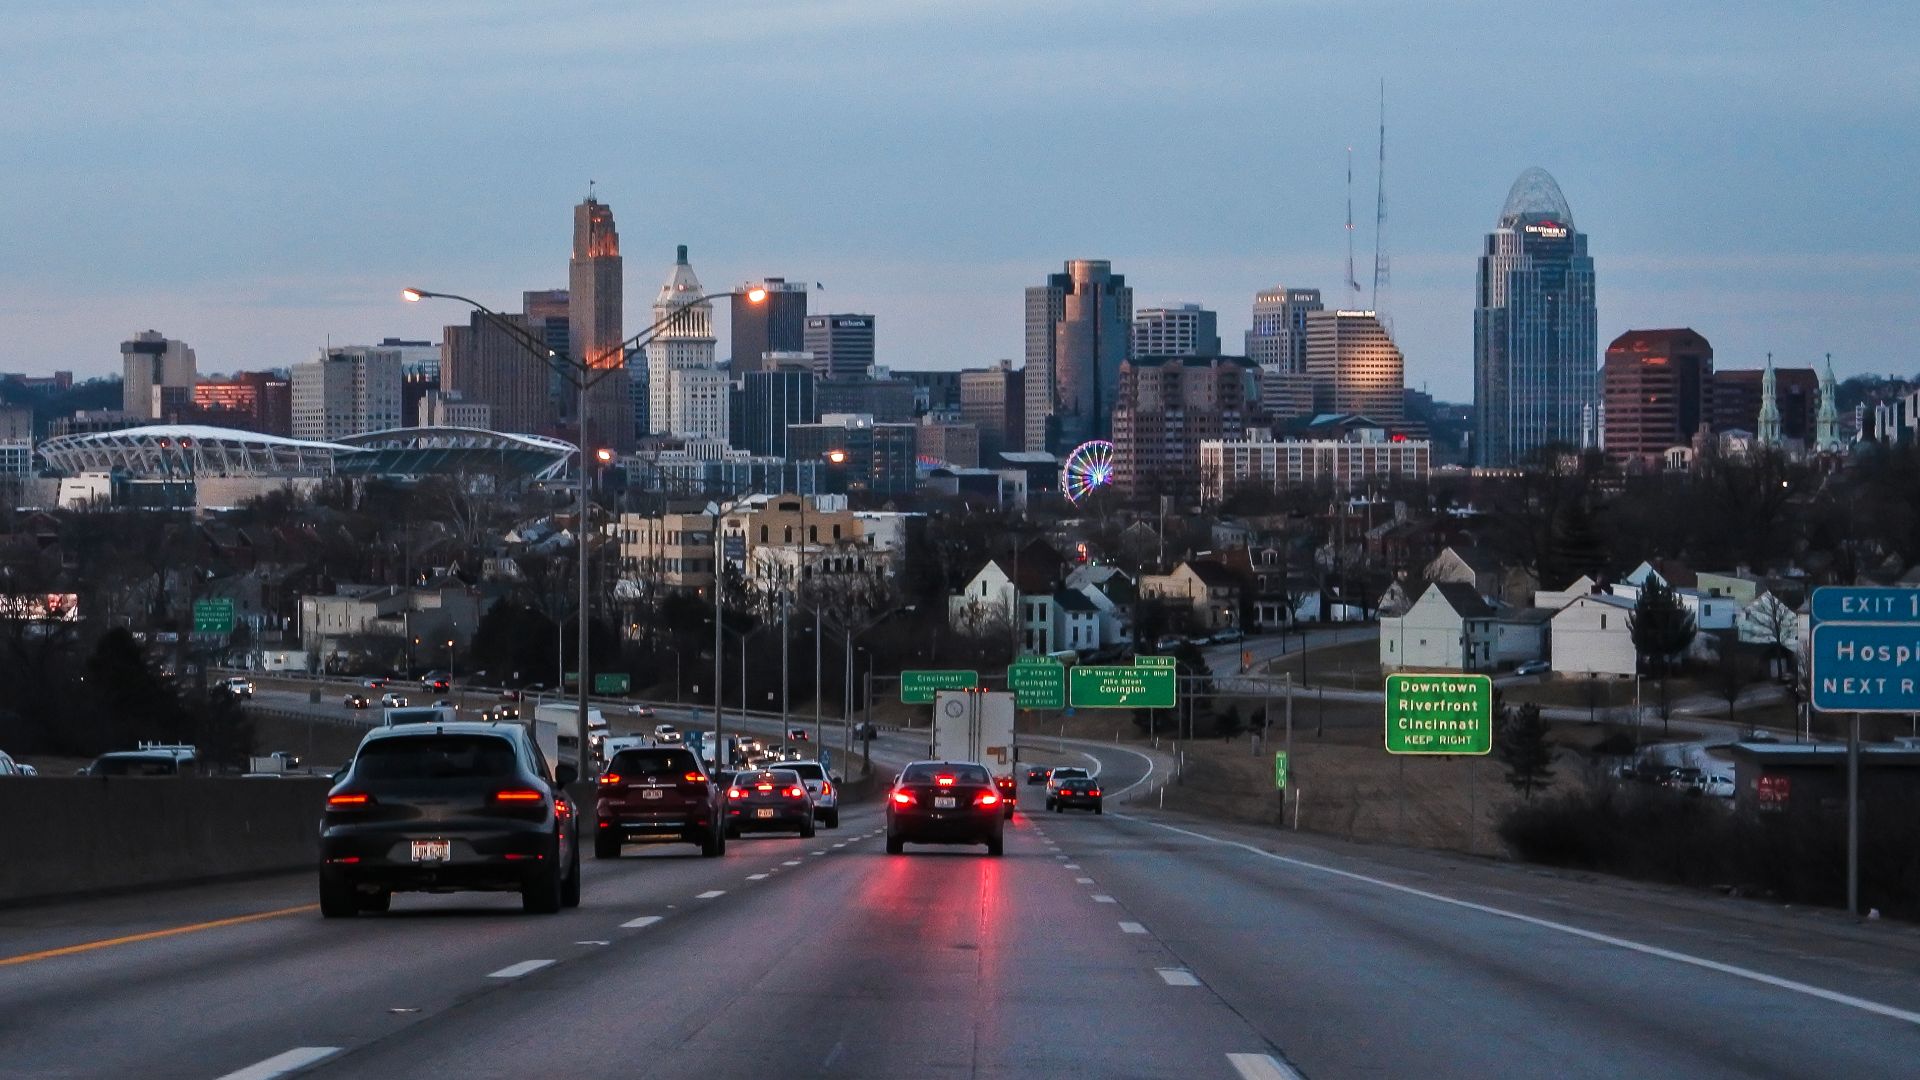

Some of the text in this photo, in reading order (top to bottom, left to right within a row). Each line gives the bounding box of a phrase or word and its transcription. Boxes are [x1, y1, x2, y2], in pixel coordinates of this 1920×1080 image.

[1842, 597, 1895, 613] EXIT
[917, 674, 962, 682] Cincinnati
[1014, 679, 1058, 688] Covington
[1100, 685, 1146, 694] Covington
[1400, 680, 1477, 693] Downtown
[1823, 677, 1887, 694] NEXT
[1018, 690, 1054, 698] Newport
[1399, 699, 1478, 711] Riverfront
[1398, 718, 1479, 730] Cincinnati
[1404, 735, 1472, 745] KEEP RIGHT
